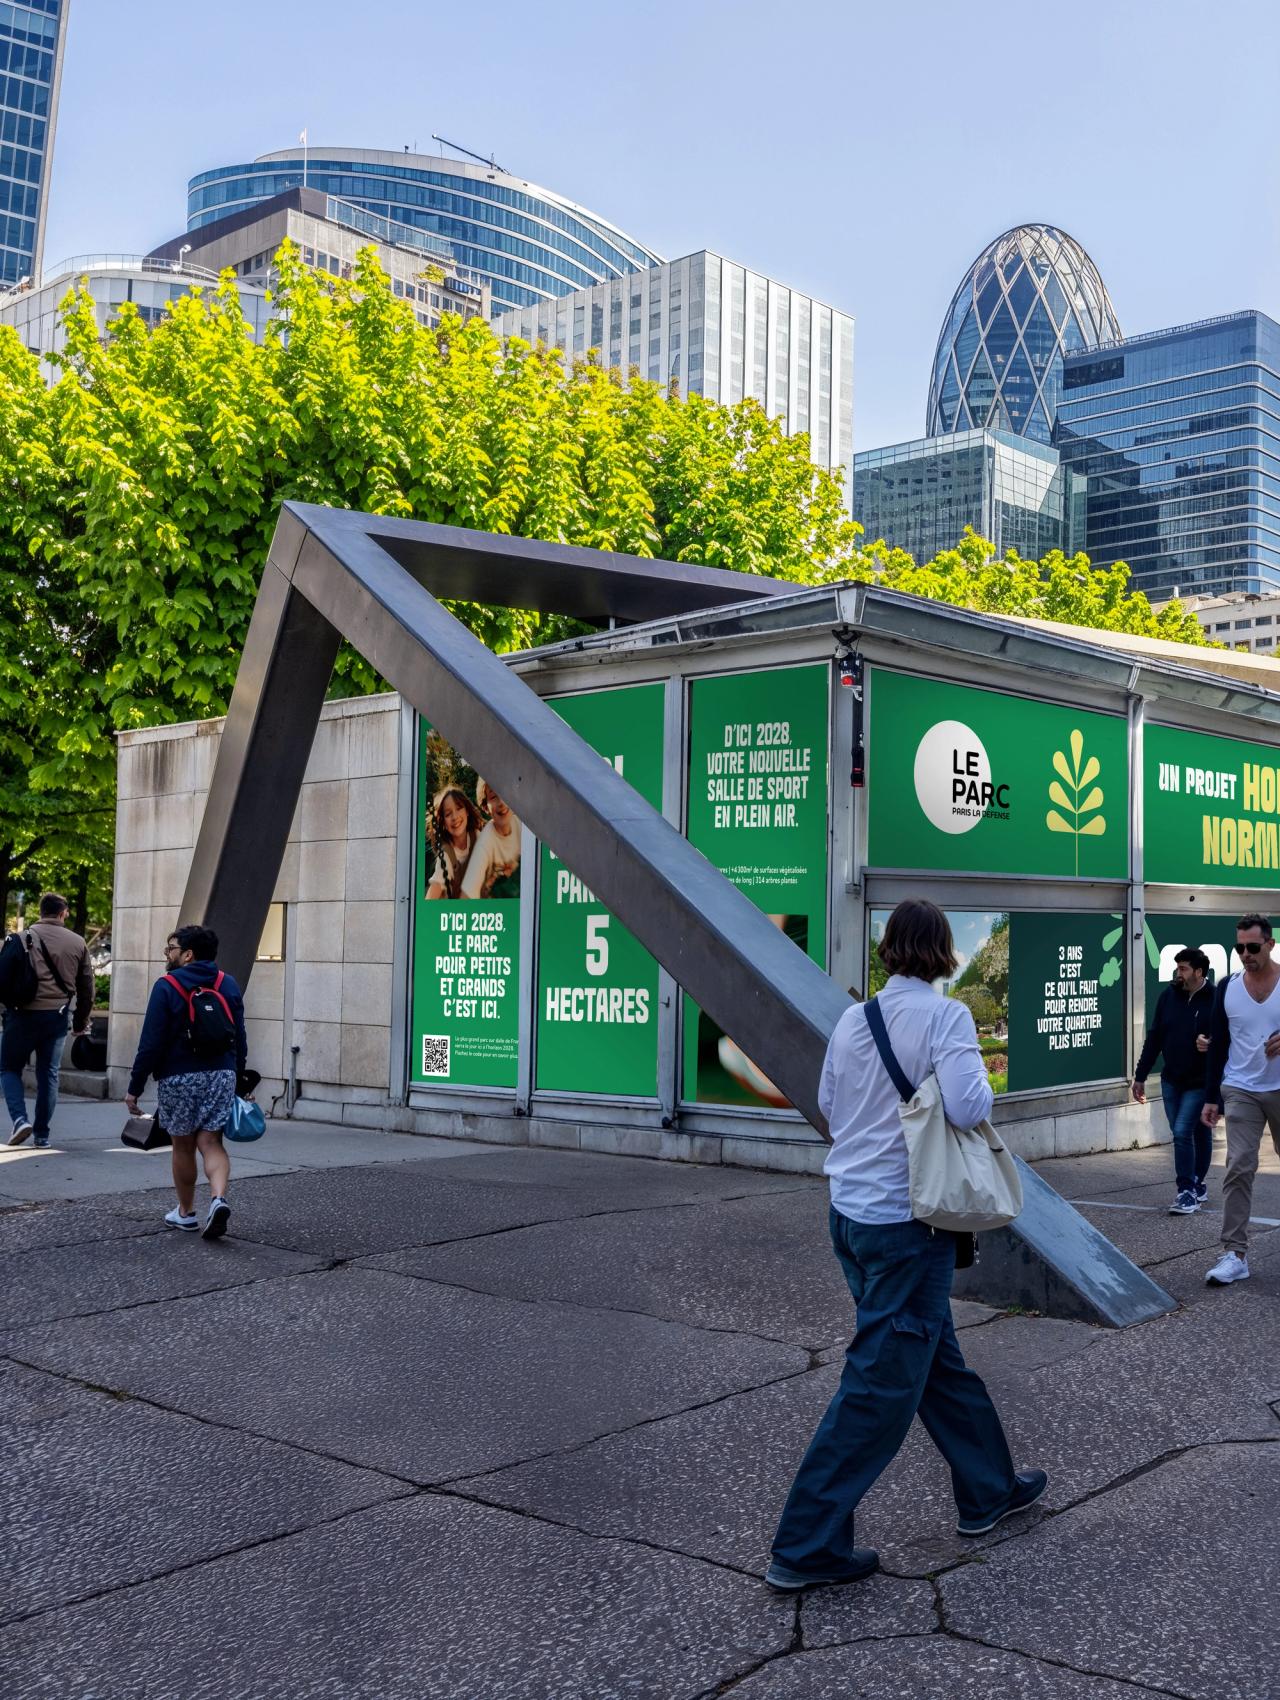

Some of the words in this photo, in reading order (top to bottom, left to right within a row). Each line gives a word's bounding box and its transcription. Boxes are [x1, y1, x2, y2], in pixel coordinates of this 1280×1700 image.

[725, 724, 751, 747] D'ICI
[757, 722, 792, 746] 2028,
[707, 752, 745, 775] VOTRE
[749, 748, 811, 773] NOUVELLE
[953, 749, 979, 777] LE
[707, 778, 744, 801] SALLE
[748, 778, 763, 801] DE
[767, 776, 809, 800] SPORT
[1159, 762, 1180, 792] UN
[1186, 767, 1237, 800] PROJET
[952, 778, 1010, 809] PARC
[715, 805, 730, 828] EN
[735, 804, 770, 828] PLEIN
[774, 804, 799, 827] AIR.
[952, 807, 971, 817] PARIS
[972, 809, 981, 817] LA
[440, 912, 467, 931] D'ICI
[471, 912, 506, 932] 2028,
[449, 934, 462, 953] LE
[466, 934, 498, 953] PARC
[585, 914, 609, 976] 5
[1059, 946, 1065, 960] 3
[1067, 945, 1083, 960] ANS
[435, 956, 466, 974] POUR
[470, 956, 511, 976] PETITS
[1060, 963, 1082, 978] C'EST
[440, 977, 454, 996] ET
[458, 978, 505, 997] GRANDS
[1045, 981, 1055, 997] CE
[1057, 981, 1077, 998] QU'IL
[1079, 980, 1098, 995] FAUT
[443, 998, 477, 1018] C'EST
[481, 1000, 500, 1019] ICI.
[546, 987, 649, 1023] HECTARES
[1045, 998, 1066, 1015] POUR
[1068, 997, 1098, 1013] RENDRE
[1037, 1017, 1063, 1034] VOTRE
[1065, 1014, 1102, 1033] QUARTIER
[1049, 1034, 1070, 1050] PLUS
[1072, 1032, 1093, 1048] VERT.
